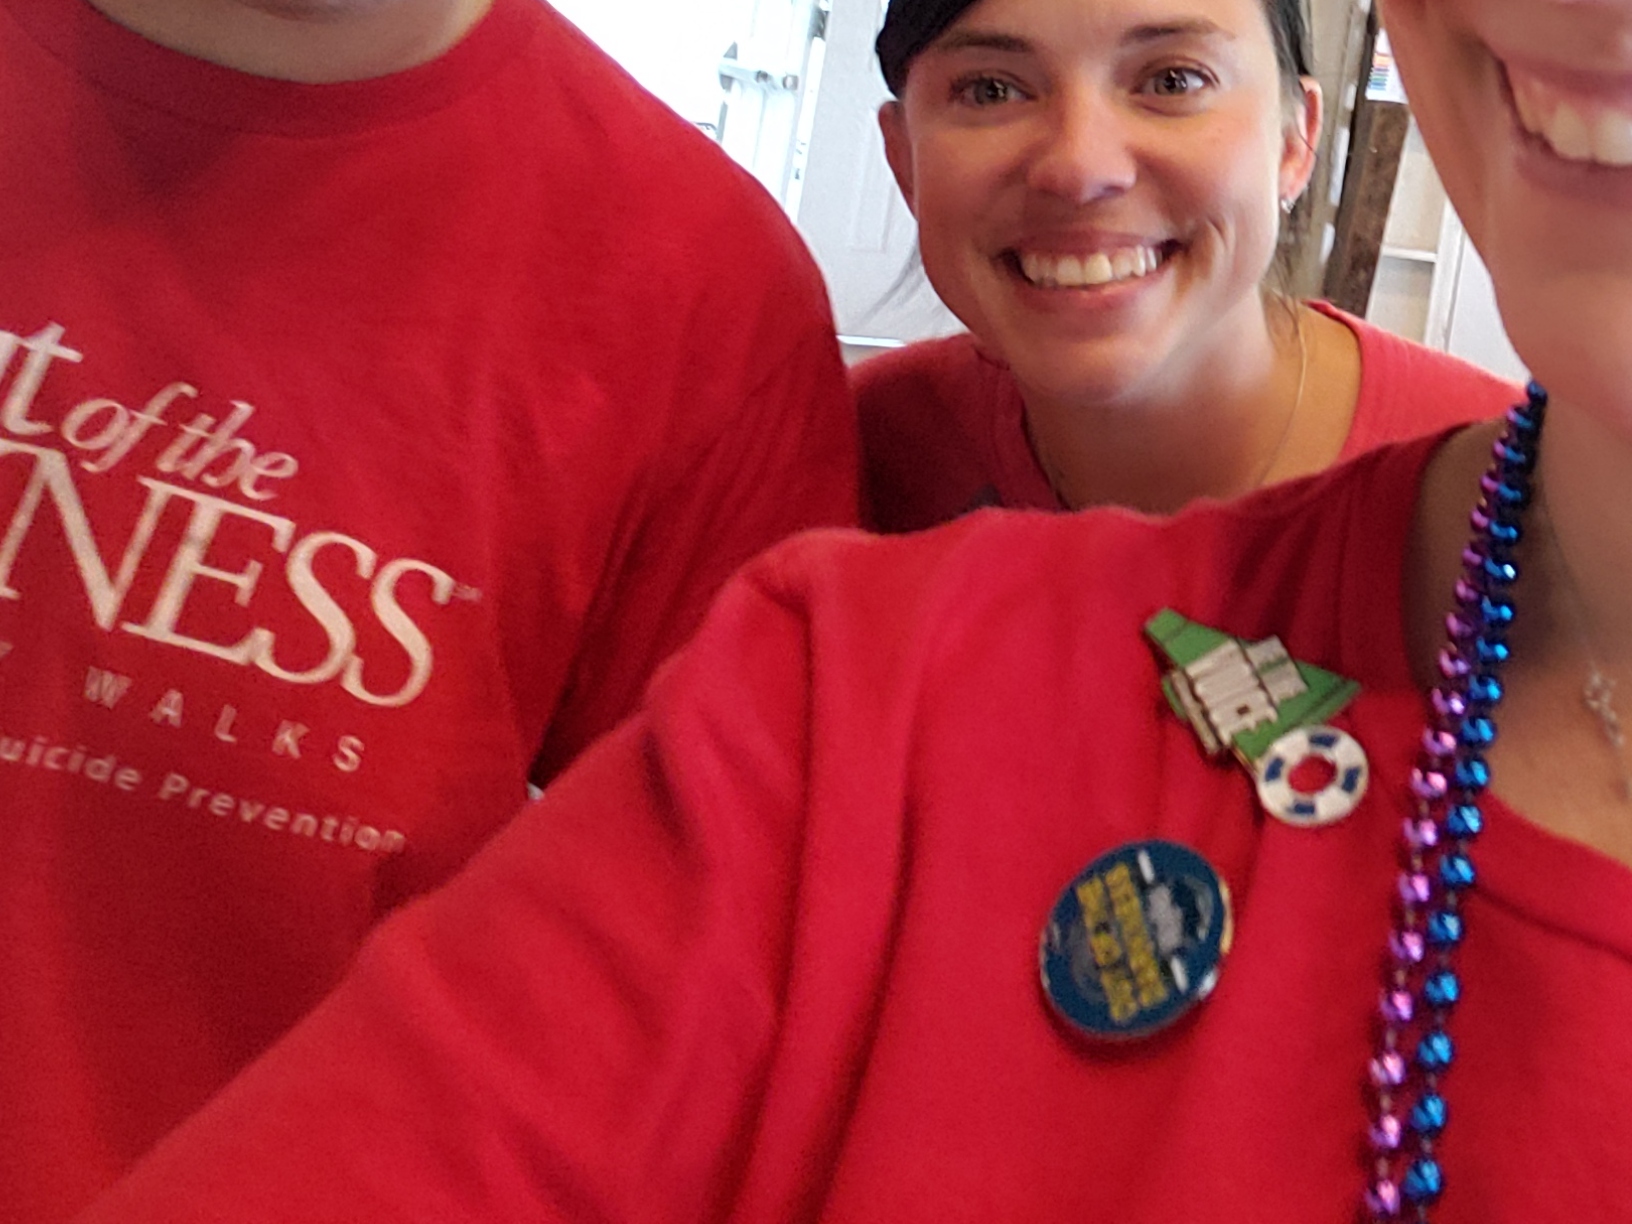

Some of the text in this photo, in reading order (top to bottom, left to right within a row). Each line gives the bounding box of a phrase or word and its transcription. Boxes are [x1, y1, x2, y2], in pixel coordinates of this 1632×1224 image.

[60, 380, 199, 473] of
[155, 399, 299, 501] the
[83, 665, 365, 772] WALKS
[158, 770, 406, 853] Prevention
